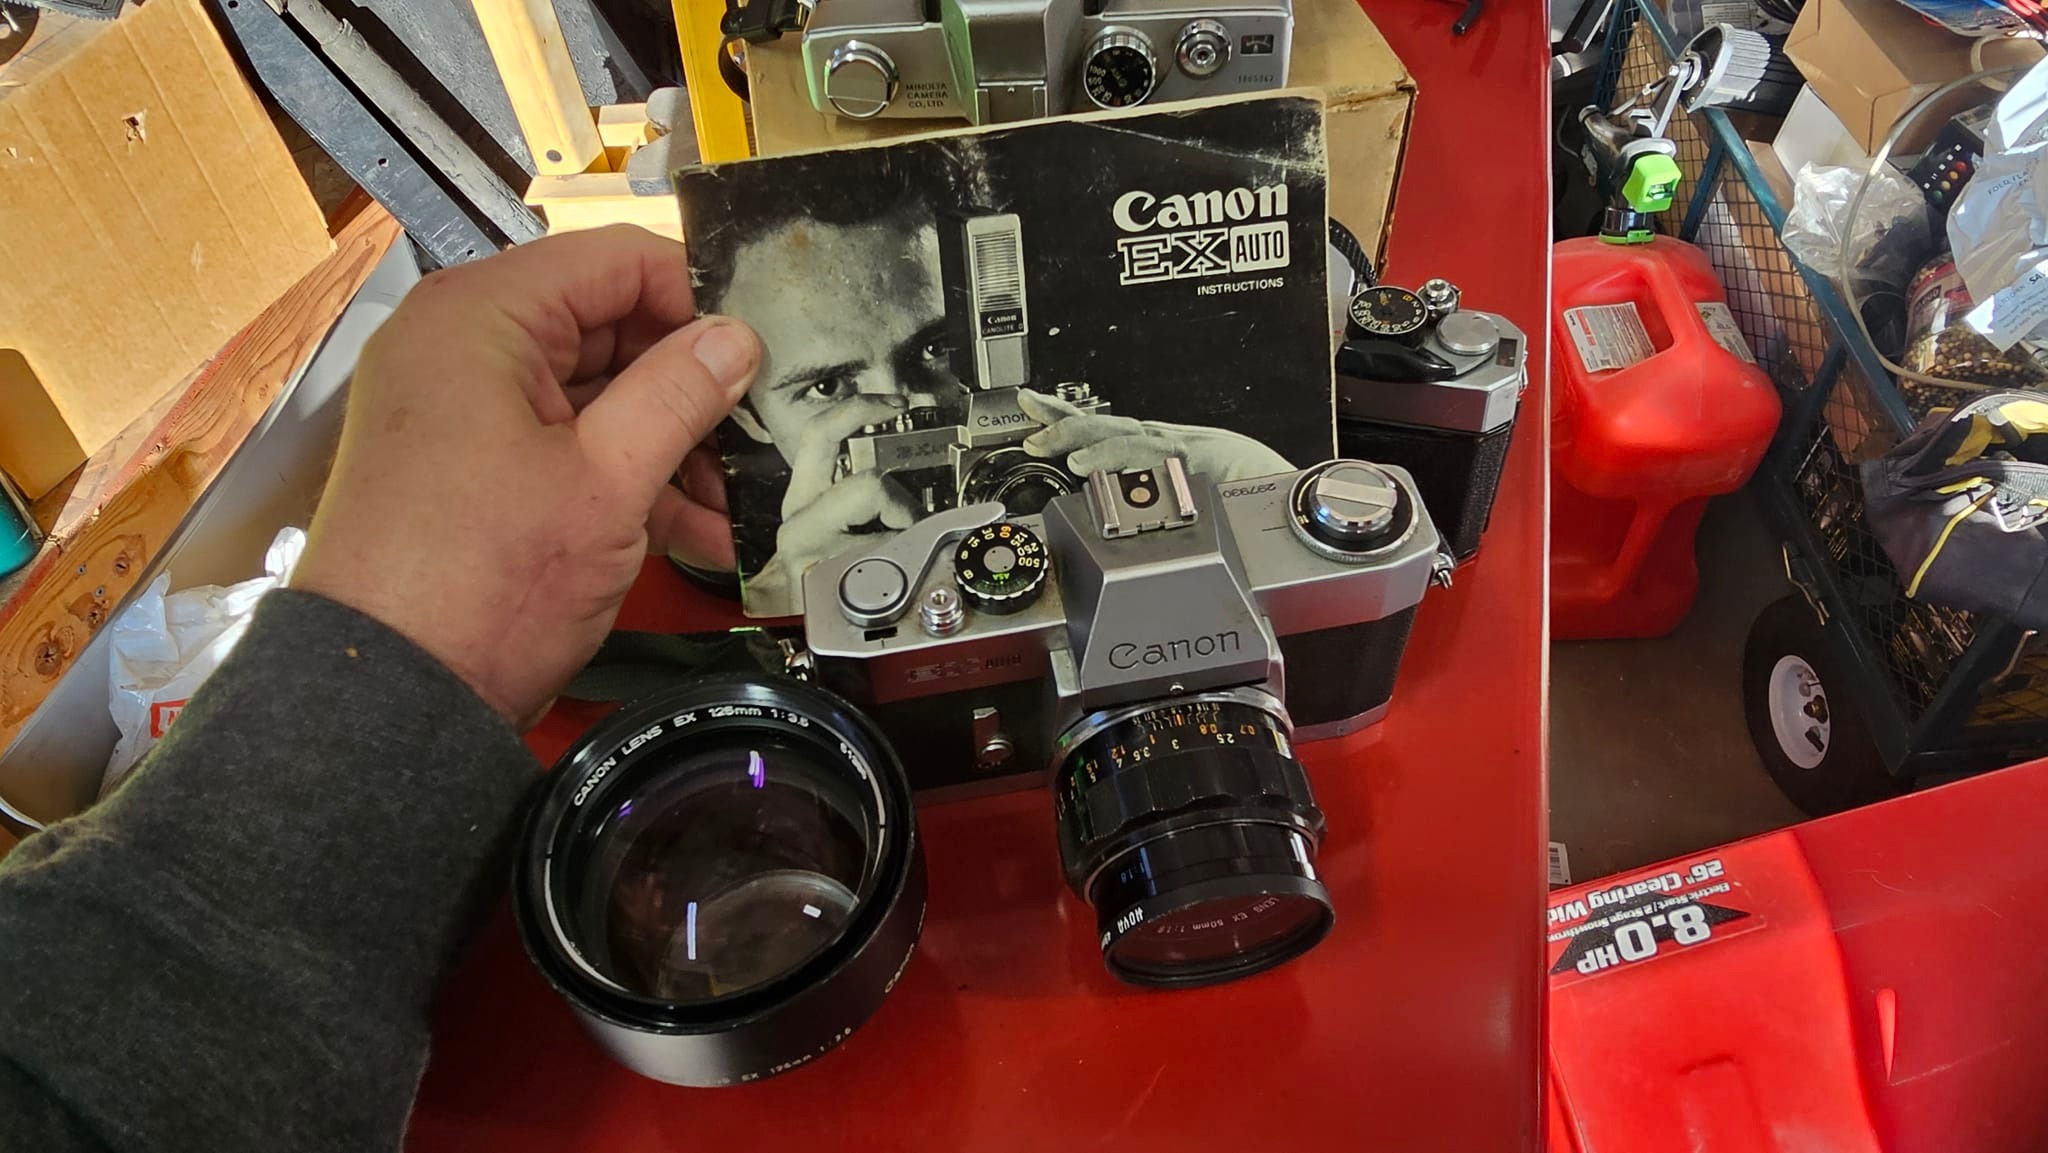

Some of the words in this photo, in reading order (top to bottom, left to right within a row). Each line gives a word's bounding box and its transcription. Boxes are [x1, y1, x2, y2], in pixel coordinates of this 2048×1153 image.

[905, 82, 948, 91] MINOLTA
[906, 91, 949, 99] CAMERA
[1112, 183, 1289, 233] Canon
[1117, 227, 1231, 286] EX
[1235, 230, 1285, 264] AUTO
[1197, 277, 1284, 296] INSTRUCTIONS
[987, 315, 1017, 325] Canon
[981, 527, 996, 541] 30
[999, 525, 1012, 539] 60
[1010, 531, 1028, 547] 125
[967, 536, 981, 549] 15
[1017, 542, 1039, 557] 250
[1018, 557, 1040, 568] 500
[1108, 630, 1240, 670] Canon
[1199, 722, 1218, 735] 0.8
[1240, 723, 1256, 736] 0.7
[1171, 739, 1180, 750] 3
[1216, 733, 1235, 744] 2.5
[574, 756, 617, 807] CANON
[621, 725, 663, 756] LENS
[673, 711, 697, 728] EX
[708, 705, 763, 718] 125mm
[1111, 744, 1126, 760] 1.2
[1132, 746, 1151, 761] 3.5
[1086, 759, 1099, 774] 1.5
[1586, 872, 1682, 910] Clearing
[1688, 881, 1731, 900] Electric
[1253, 896, 1280, 913] LENS
[1117, 906, 1144, 934] HOYA
[1232, 911, 1249, 922] EX
[1609, 907, 1644, 924] Stage
[1192, 919, 1224, 931] 50mm
[1614, 904, 1712, 962] 8.0
[1576, 943, 1620, 974] HP
